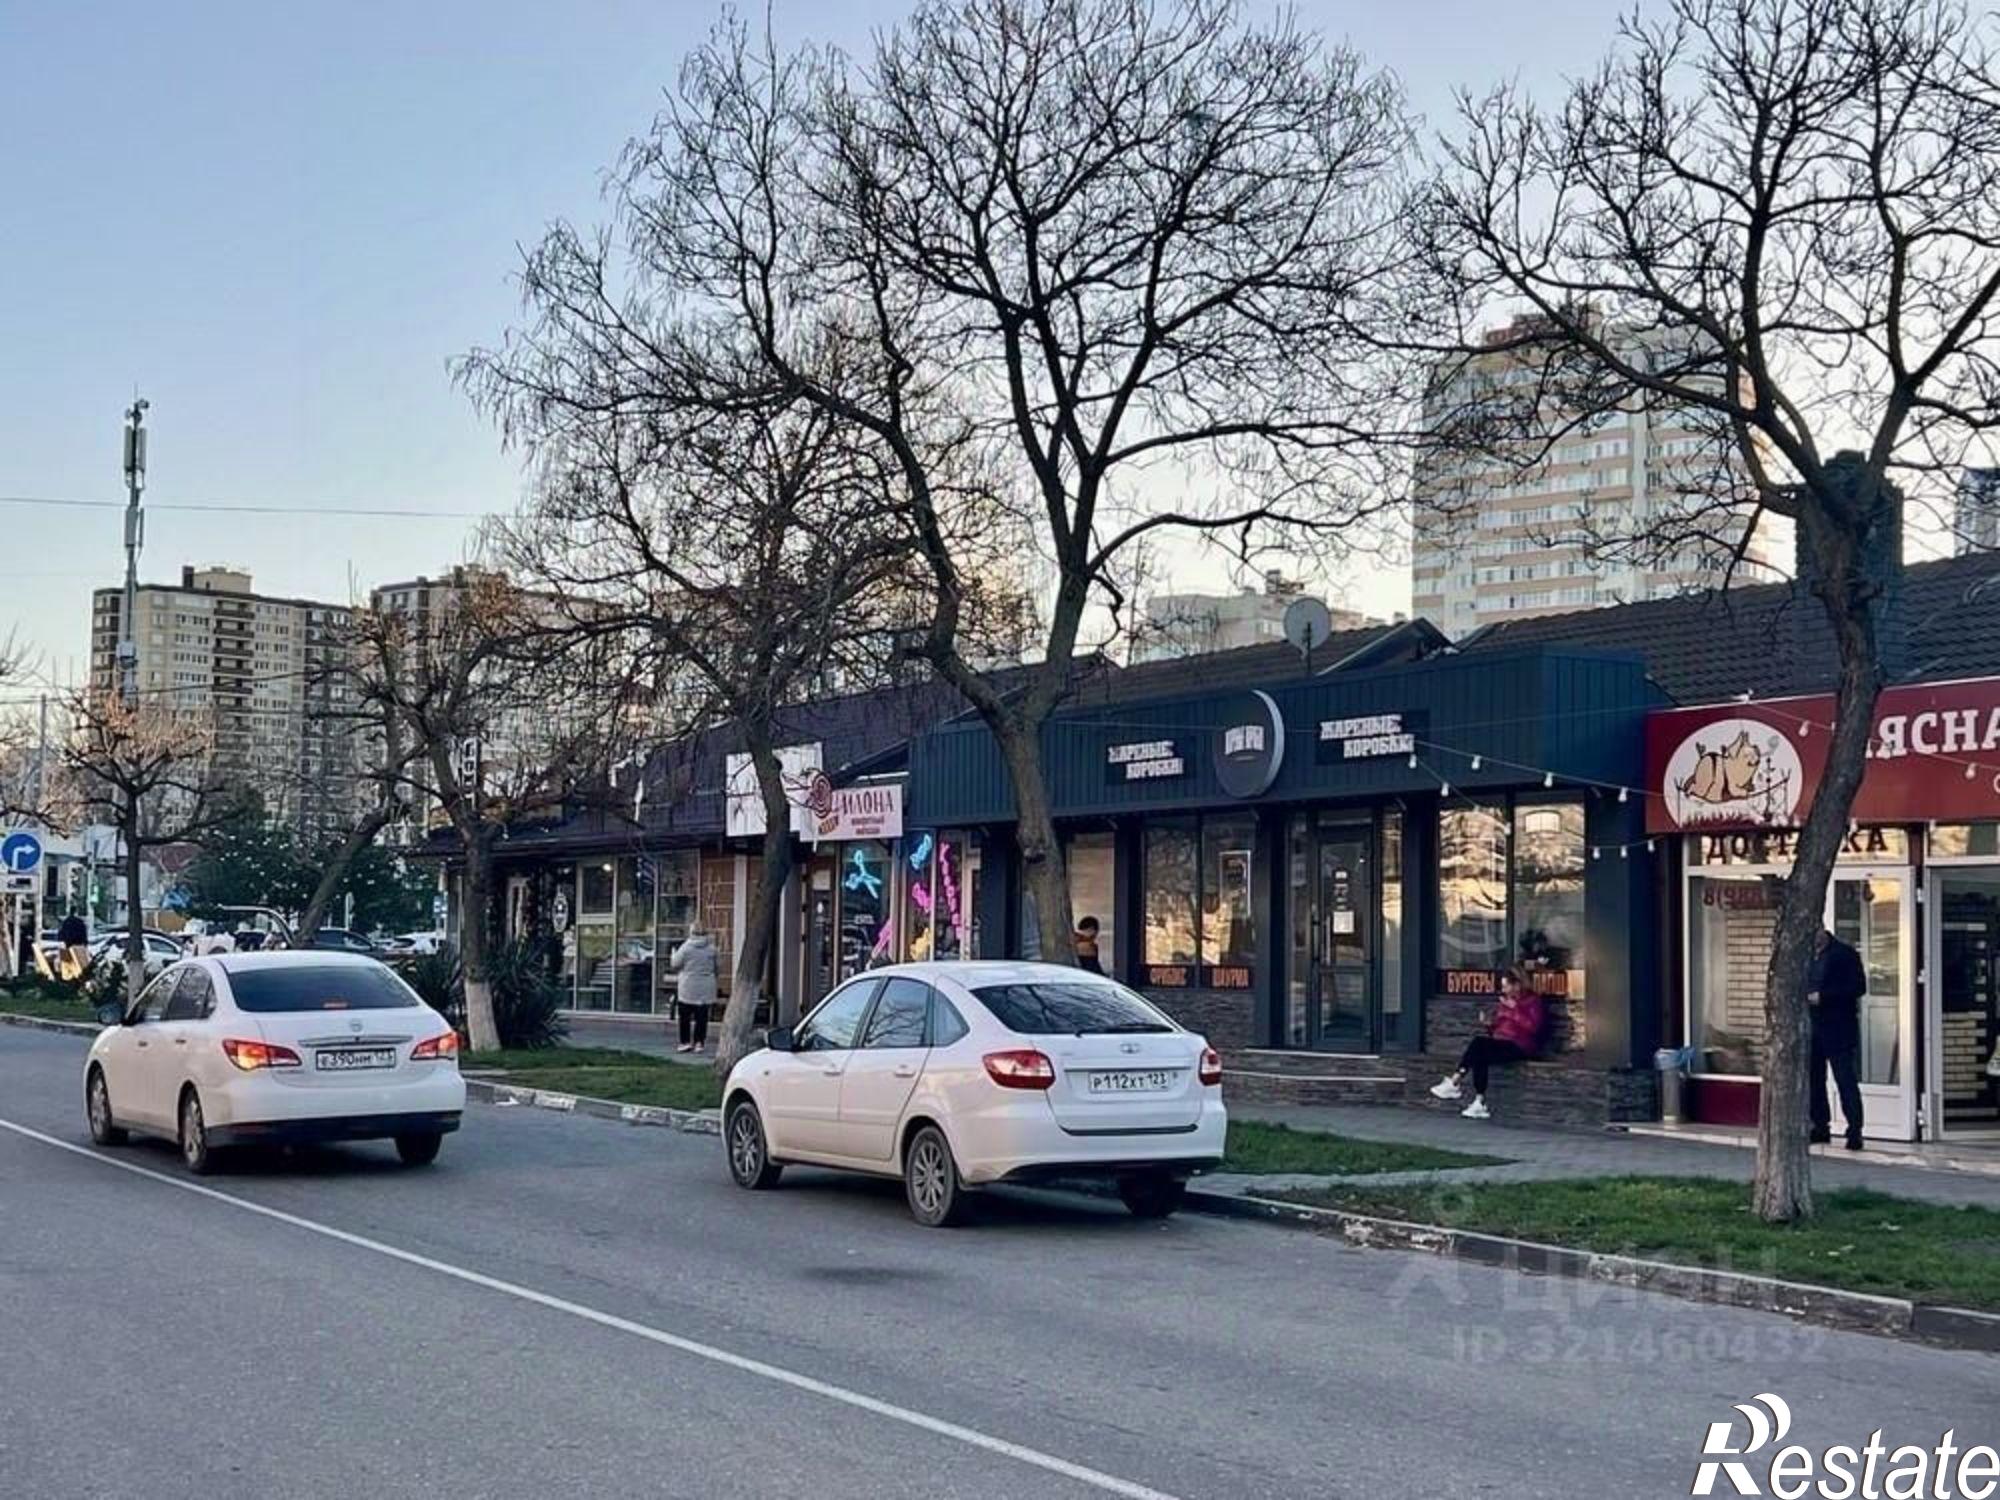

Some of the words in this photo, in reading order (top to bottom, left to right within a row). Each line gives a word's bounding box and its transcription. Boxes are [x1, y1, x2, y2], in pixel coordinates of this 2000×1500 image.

[1320, 714, 1403, 740] ЖАРЕНЫЕ
[1343, 733, 1415, 758] КОРОБКИ
[1447, 971, 1495, 993] БУРГЕРЫ
